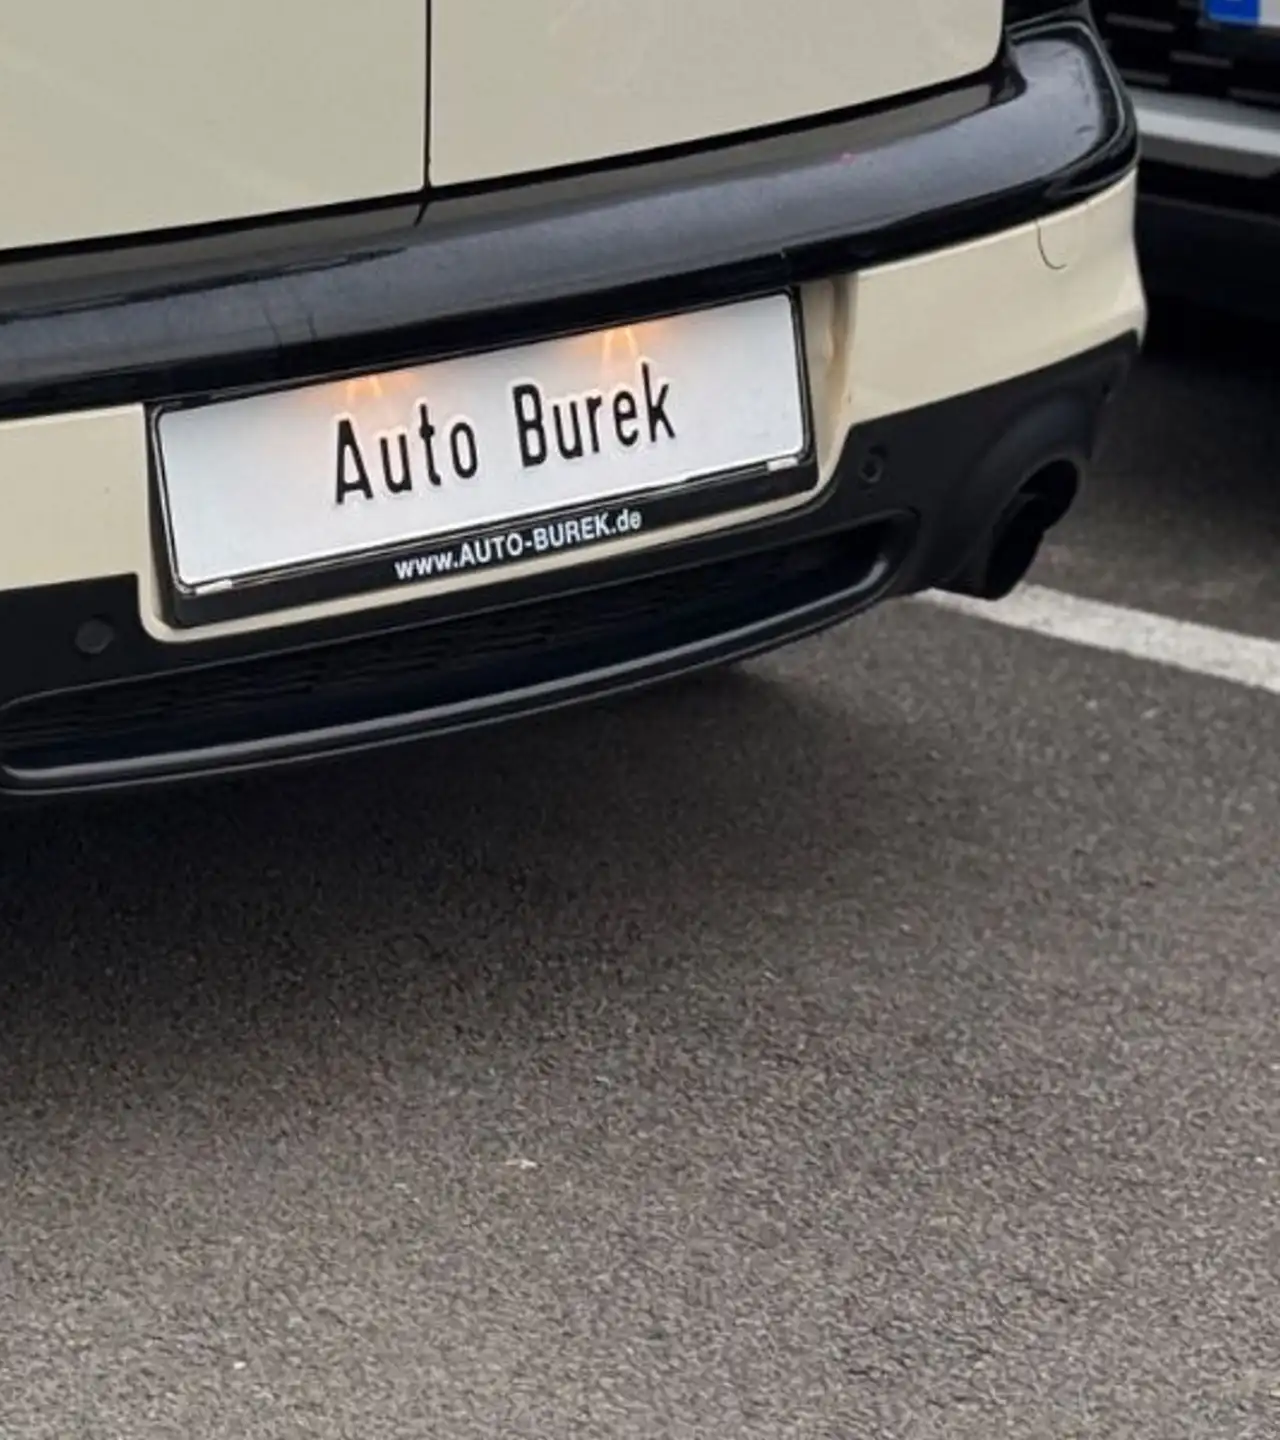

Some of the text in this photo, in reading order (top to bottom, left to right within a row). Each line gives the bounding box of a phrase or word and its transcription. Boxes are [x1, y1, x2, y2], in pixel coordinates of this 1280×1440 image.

[333, 361, 677, 506] Auto Burek
[394, 508, 643, 581] www.AUTO-BUREK.de
